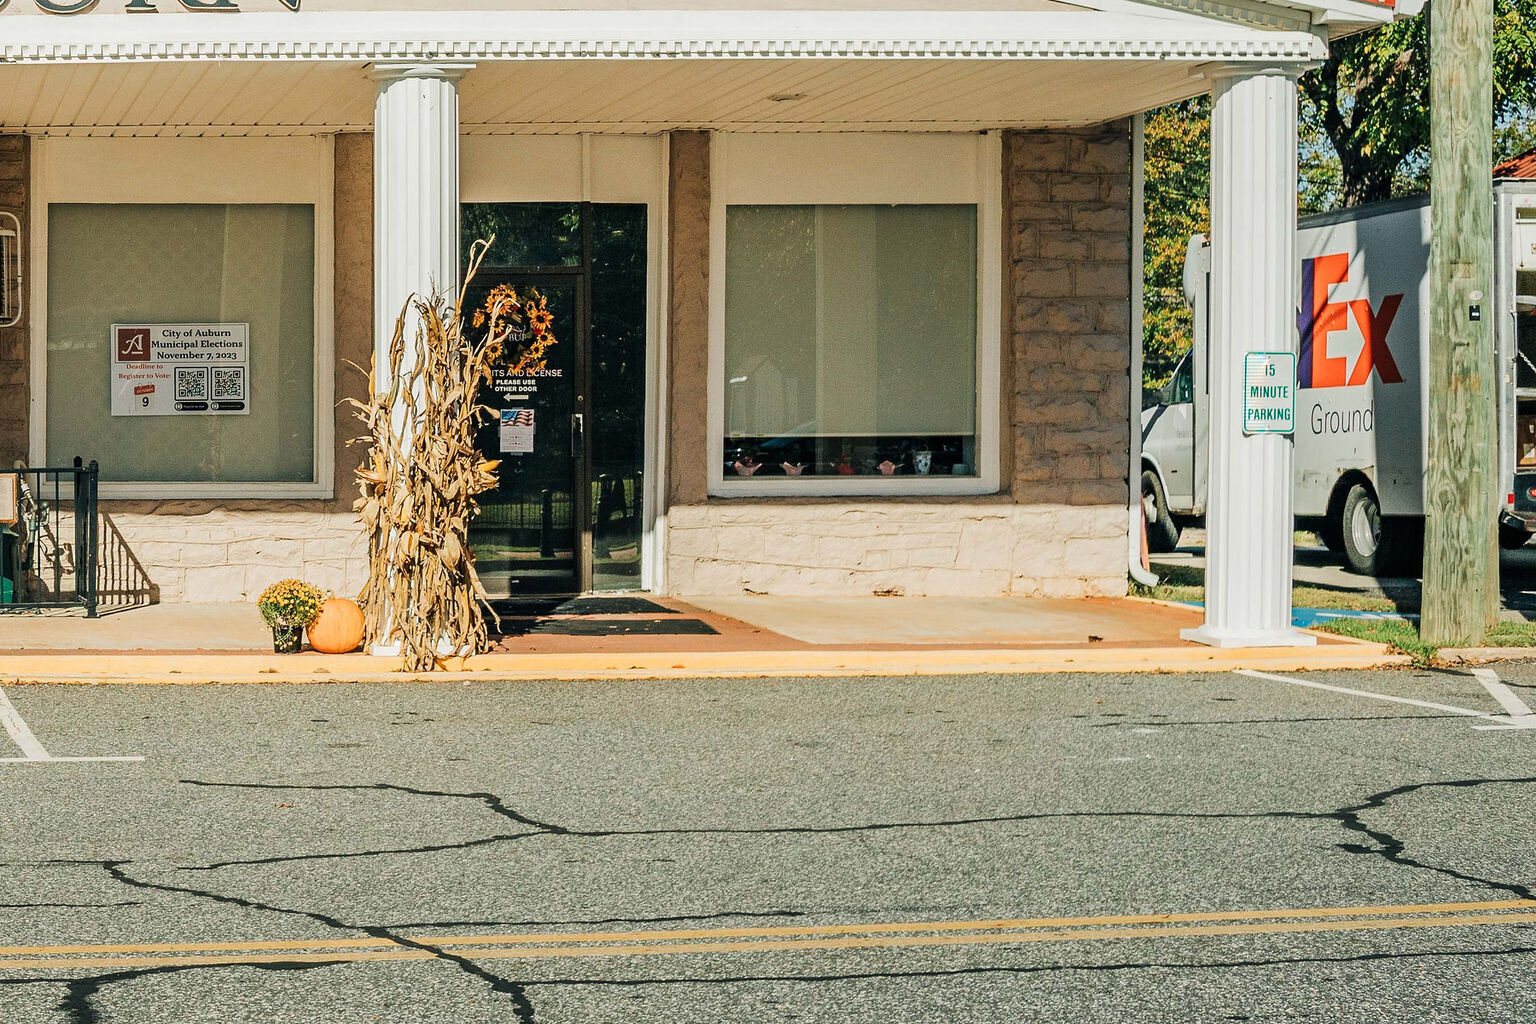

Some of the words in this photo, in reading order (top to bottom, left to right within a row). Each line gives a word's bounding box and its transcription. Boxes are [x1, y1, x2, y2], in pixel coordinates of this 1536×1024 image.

[162, 329, 181, 339] City
[183, 329, 193, 337] of
[195, 329, 231, 337] Auburn
[151, 340, 198, 350] Municipal
[200, 340, 243, 348] Elections
[157, 351, 204, 359] November
[206, 352, 214, 361] 7,
[216, 352, 237, 360] 2023
[526, 369, 563, 377] LCENSE
[1265, 364, 1276, 377] 15
[1250, 386, 1289, 399] MINUTE
[142, 396, 149, 407] 9
[1248, 408, 1291, 421] PARKING
[1311, 400, 1375, 435] Ground
